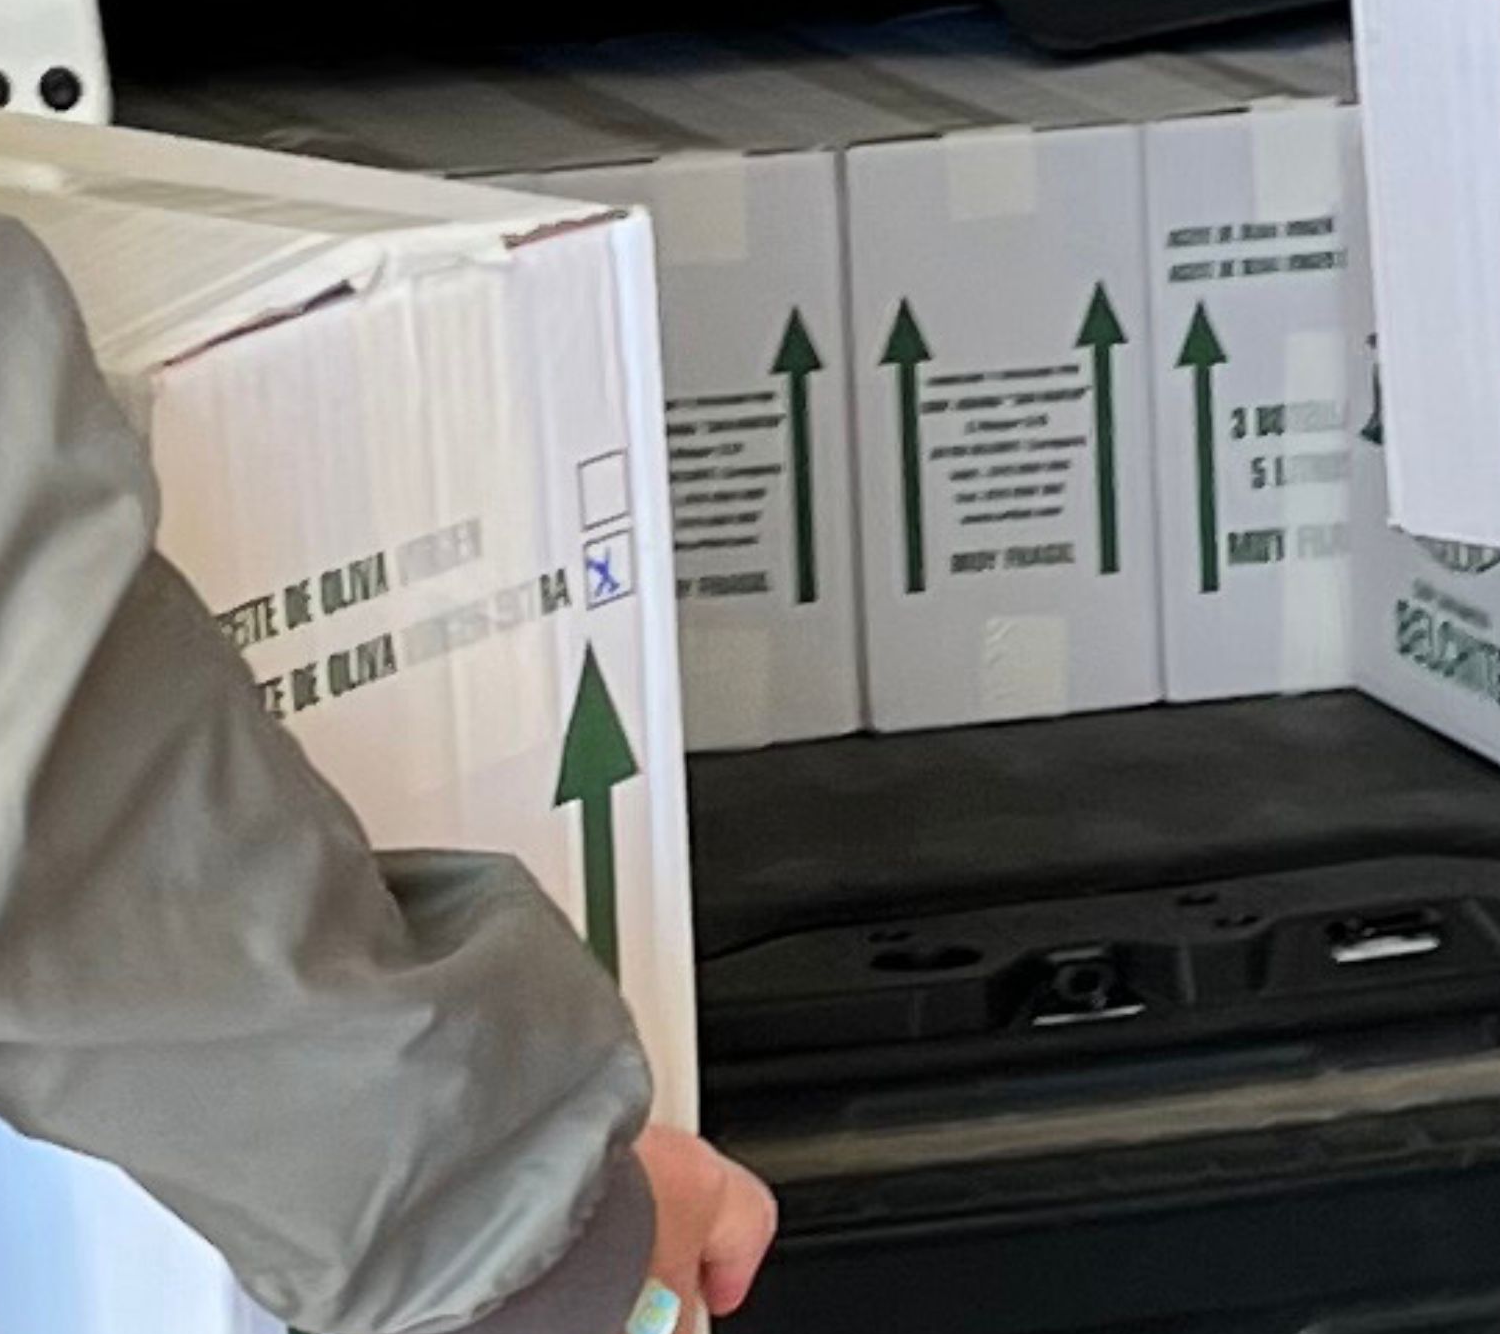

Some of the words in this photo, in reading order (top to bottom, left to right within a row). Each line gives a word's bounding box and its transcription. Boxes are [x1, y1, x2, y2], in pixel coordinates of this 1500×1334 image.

[285, 577, 314, 630] DE
[319, 551, 389, 616] OLIVA
[293, 662, 321, 713] DE
[328, 632, 399, 697] OLIVA
